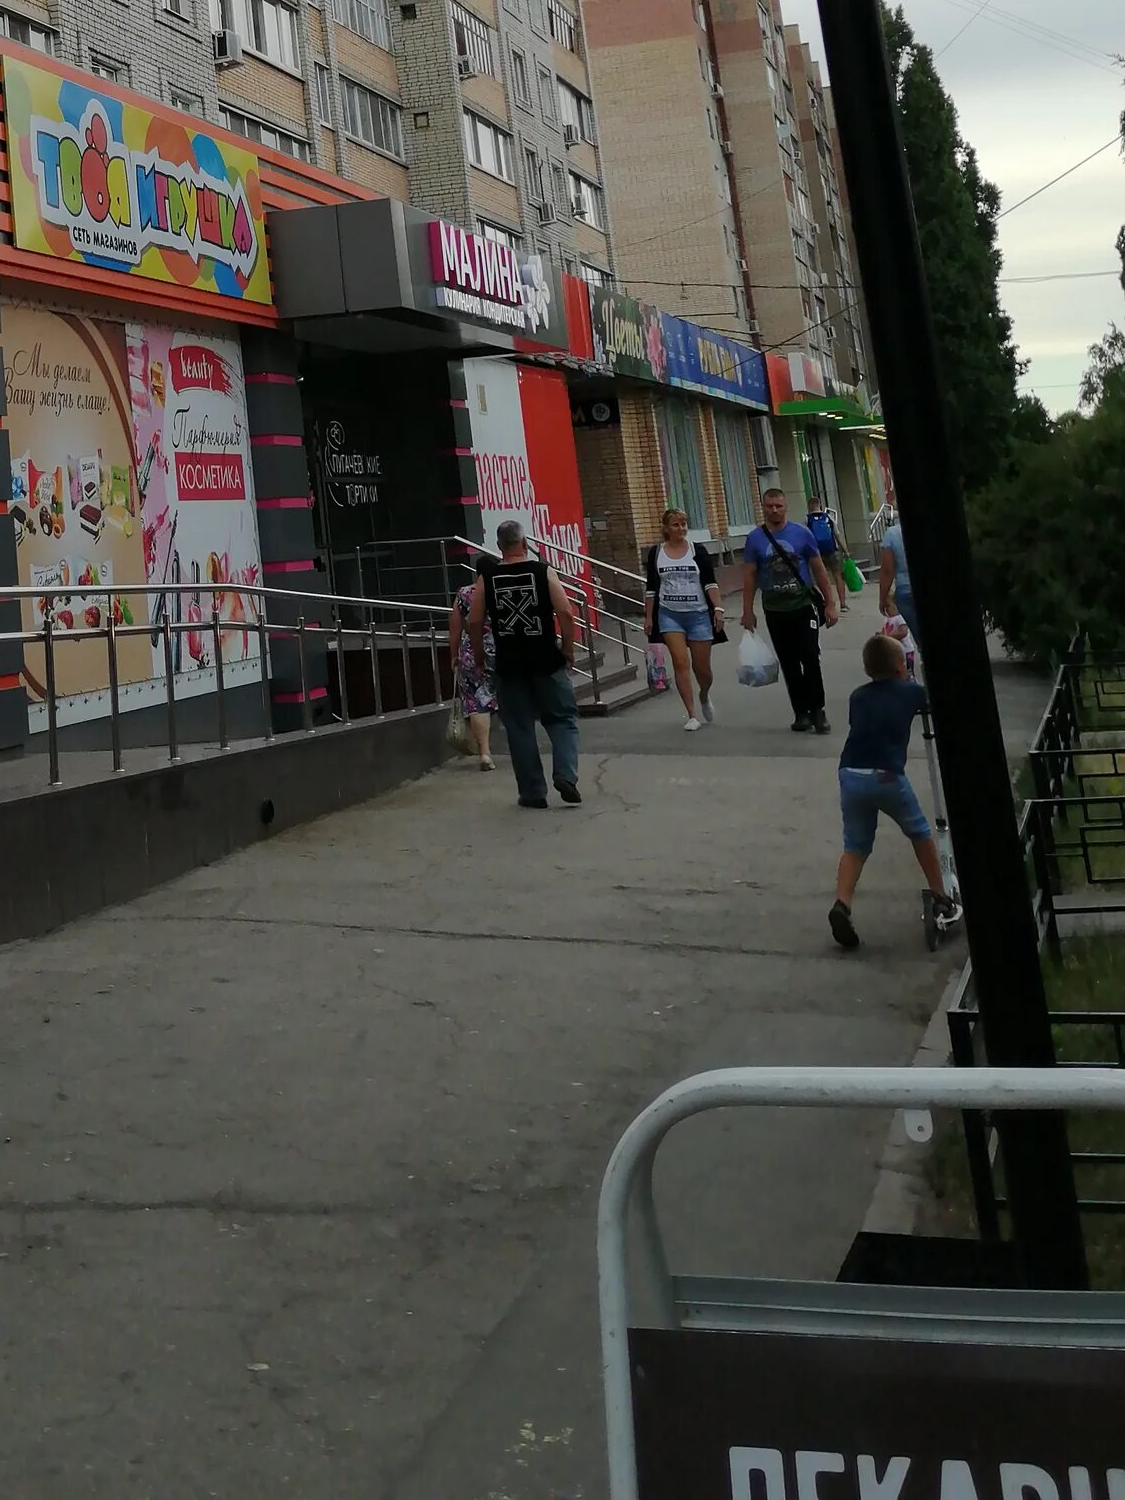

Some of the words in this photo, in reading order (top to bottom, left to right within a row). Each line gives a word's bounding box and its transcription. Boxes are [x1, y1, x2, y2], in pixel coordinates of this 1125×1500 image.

[36, 113, 132, 230] ТВОЯ
[136, 161, 253, 258] ИГРУШКА
[72, 226, 91, 245] СЕТЬ
[93, 231, 138, 257] МАГАЗИНОВ
[439, 219, 524, 305] МАЛИНА
[601, 298, 645, 366] Цветы
[3, 367, 36, 417] Вашу
[40, 389, 74, 418] жизнь
[13, 342, 50, 379] Мы
[54, 363, 91, 390] делаем
[179, 348, 214, 391] beauty
[172, 404, 242, 462] Парфюмерия
[178, 464, 242, 490] КОСМЕТИКА
[475, 451, 530, 511] расное
